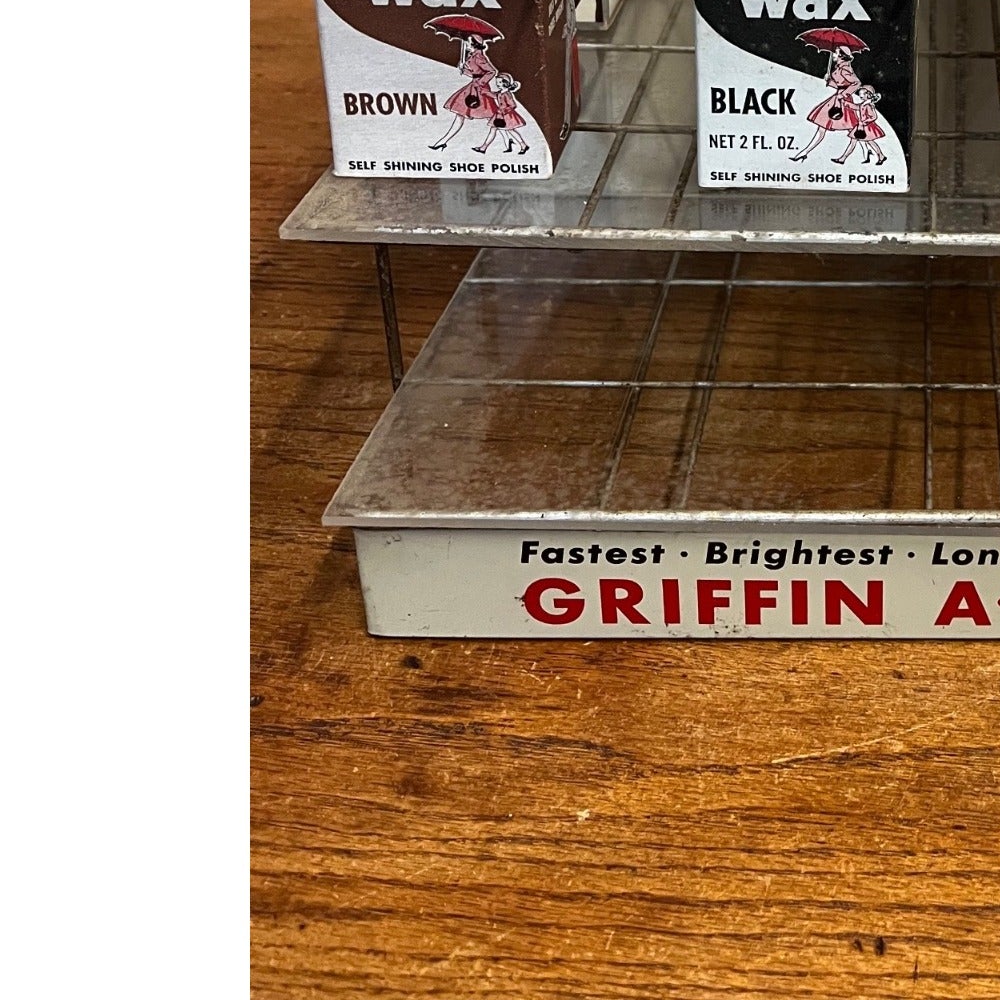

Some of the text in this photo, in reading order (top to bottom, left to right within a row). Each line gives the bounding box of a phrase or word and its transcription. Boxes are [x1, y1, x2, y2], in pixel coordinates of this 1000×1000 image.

[343, 92, 438, 116] BROWN
[710, 86, 796, 115] BLACK
[709, 134, 799, 150] NET 2 FL. OZ.
[348, 160, 540, 174] SELF SHINING SHOE POLISH
[710, 171, 895, 185] SELF SHINING SHOE POLISH
[520, 540, 665, 565] Fastest
[705, 541, 893, 570] Brightest
[523, 577, 883, 625] GRIFFIN
